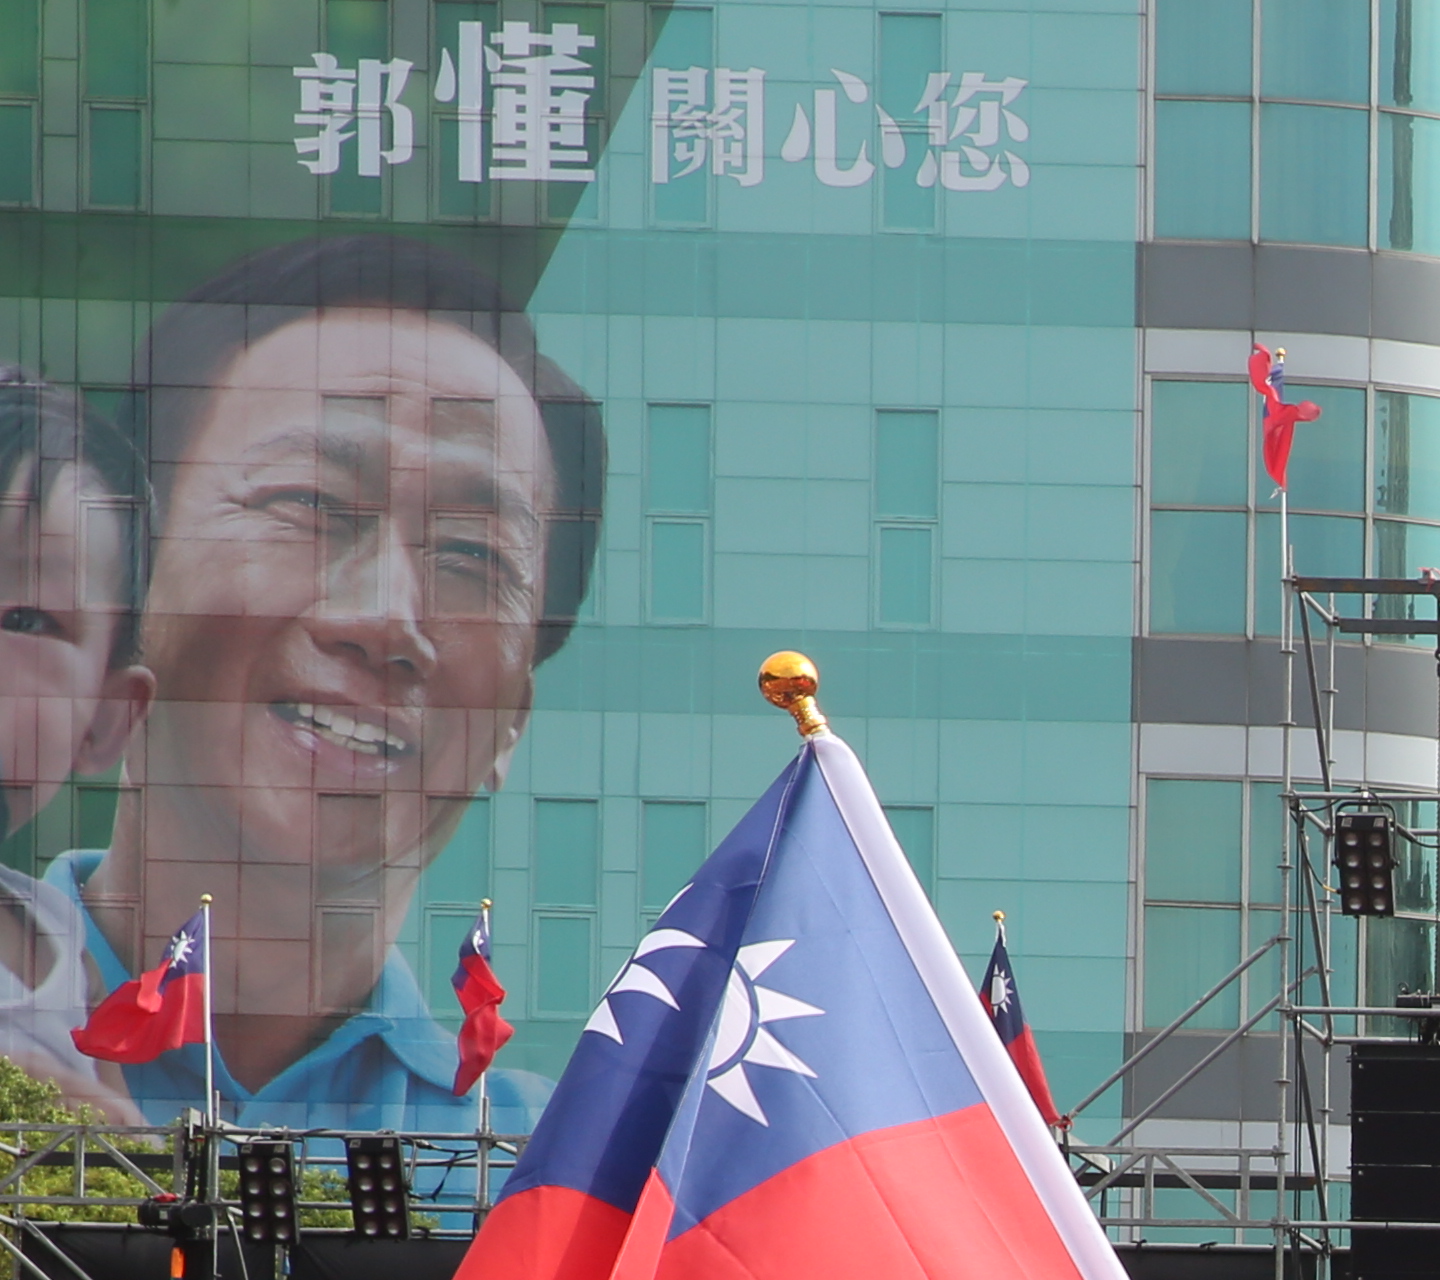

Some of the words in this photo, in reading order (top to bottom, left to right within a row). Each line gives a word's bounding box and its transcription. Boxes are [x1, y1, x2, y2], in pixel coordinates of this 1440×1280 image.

[291, 20, 597, 183] 郭懂
[650, 66, 1032, 192] 關心您
